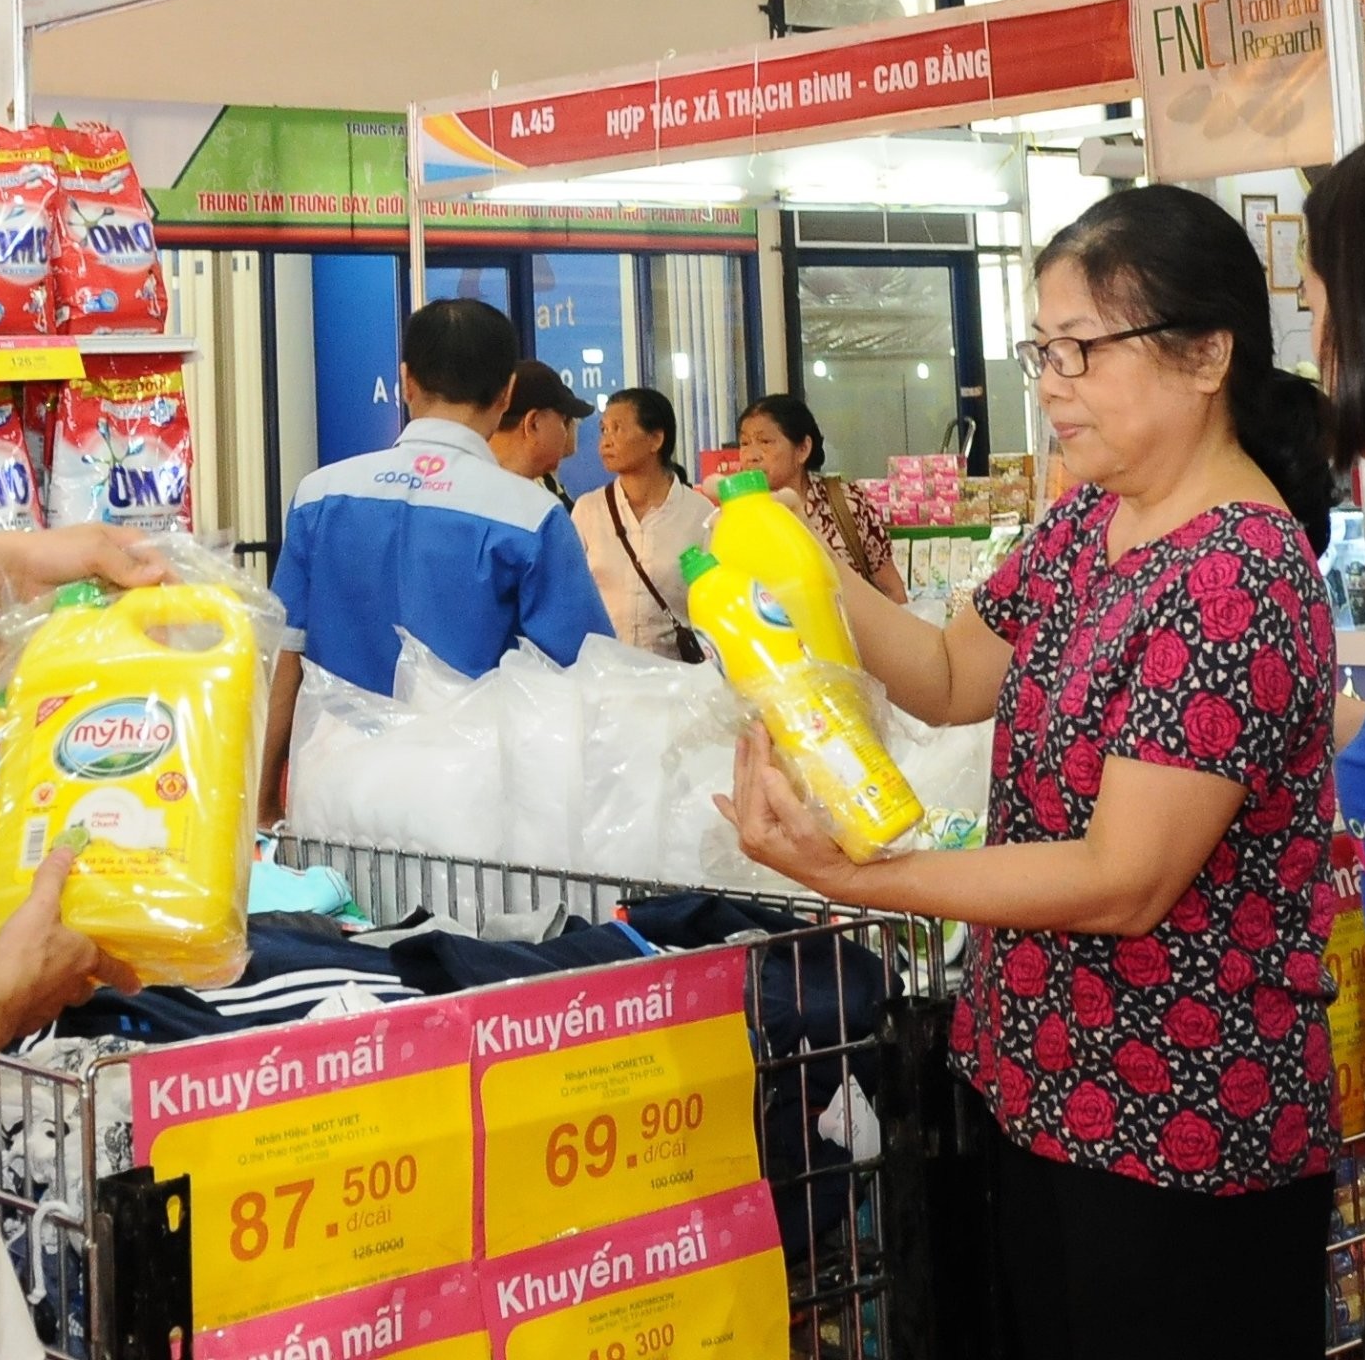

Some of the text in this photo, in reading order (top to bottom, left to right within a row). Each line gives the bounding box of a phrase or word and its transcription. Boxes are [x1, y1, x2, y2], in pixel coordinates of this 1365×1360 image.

[1241, 20, 1323, 62] Research
[510, 110, 556, 139] A.45
[605, 105, 645, 138] HỢP
[650, 95, 689, 130] TÁC
[692, 86, 722, 124] XÃ
[725, 80, 795, 121] THẠCH
[799, 67, 853, 108] BÌNH
[874, 62, 917, 95] CAO
[924, 44, 992, 88] BẰNG
[344, 122, 387, 137] TRUNG
[197, 192, 248, 214] TRUNG
[89, 222, 153, 255] OMO
[475, 983, 674, 1057] Khuyến mãi
[149, 1036, 385, 1119] Khuyến mãi
[496, 1240, 635, 1319] Khuyến
[645, 1223, 708, 1275] mãi
[341, 1303, 403, 1360] mãi
